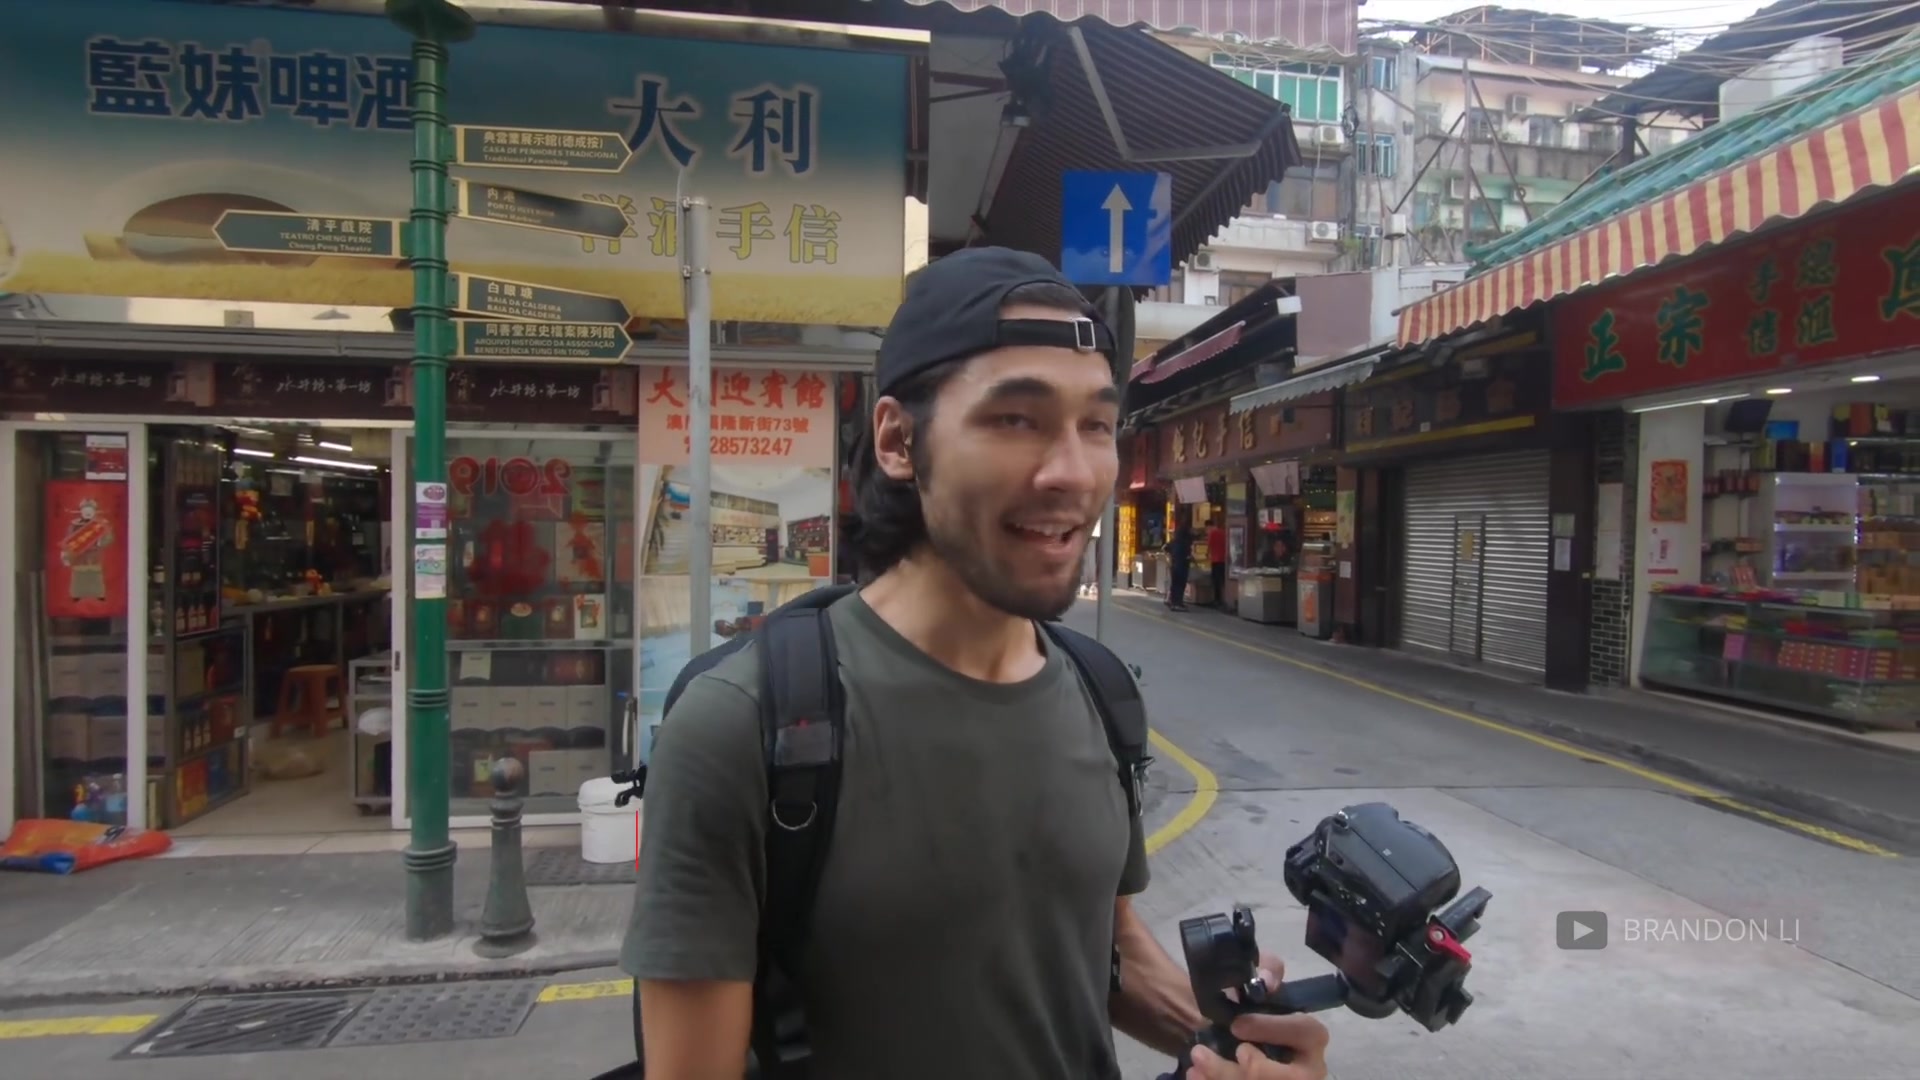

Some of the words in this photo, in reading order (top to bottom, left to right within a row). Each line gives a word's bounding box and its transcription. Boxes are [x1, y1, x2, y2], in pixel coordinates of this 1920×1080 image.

[87, 38, 414, 130] 藍妹啤酒
[611, 80, 815, 174] 大利
[484, 154, 527, 163] Traditional
[519, 148, 564, 157] PENHORES
[565, 149, 619, 160] TRADICIONAL
[280, 232, 314, 241] TEATRO
[316, 233, 347, 242] CHENG
[348, 235, 372, 244] PENG
[508, 298, 520, 306] DA
[521, 301, 561, 312] CALDEIRA
[521, 309, 561, 320] CALDEIRA
[475, 338, 510, 346] ARQUIVO
[565, 339, 615, 349] ASSOCIAÇÃO
[553, 348, 567, 356] SIN
[568, 348, 590, 356] TONG
[710, 437, 793, 456] 28573247
